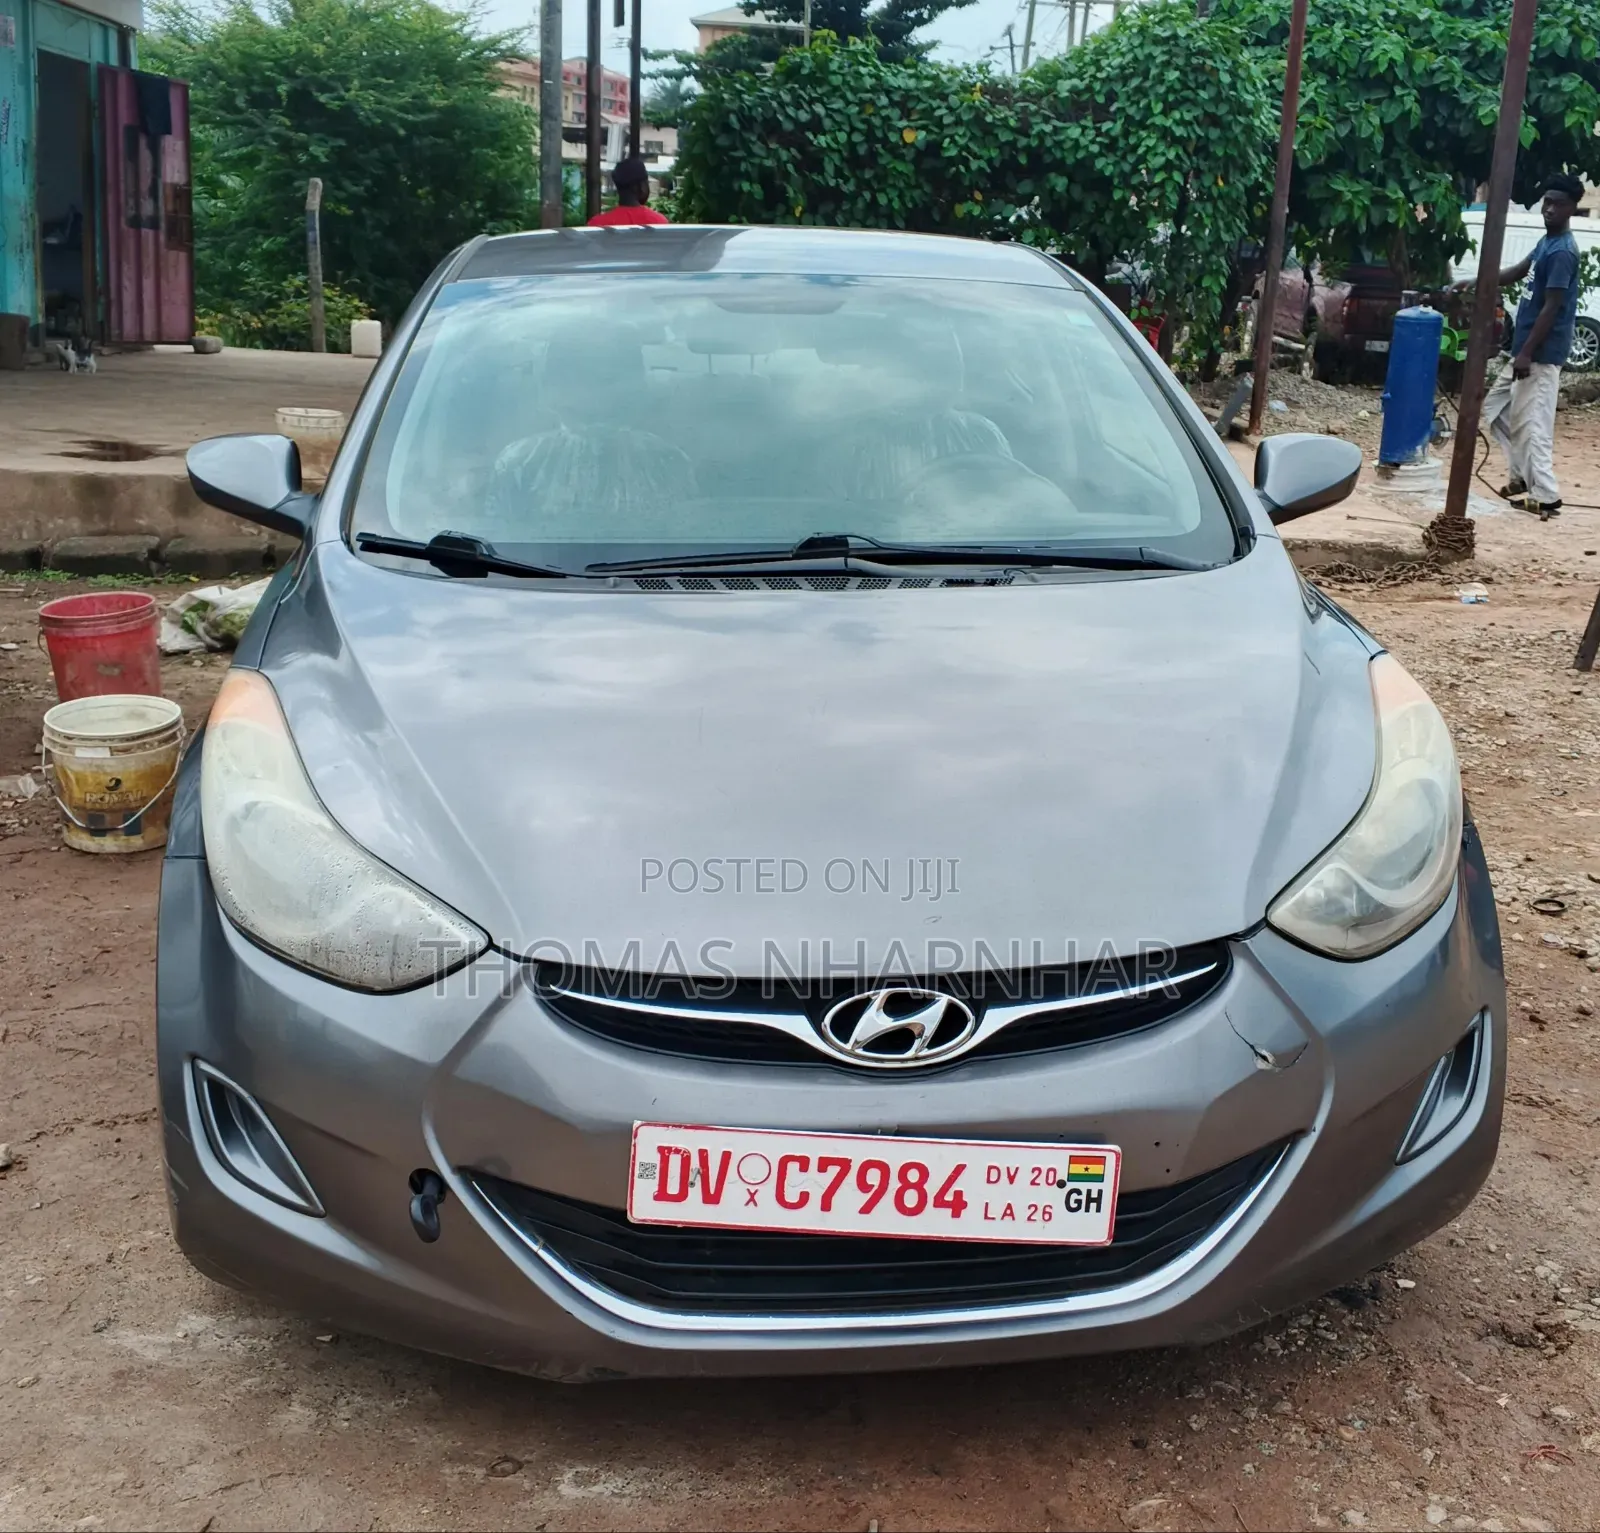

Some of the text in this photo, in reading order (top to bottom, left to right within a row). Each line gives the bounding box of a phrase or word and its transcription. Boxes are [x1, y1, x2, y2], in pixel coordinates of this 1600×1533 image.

[653, 1146, 968, 1218] DV C7984
[986, 1165, 1057, 1186] DV 20
[984, 1202, 1053, 1222] LA 26
[1064, 1188, 1103, 1213] GH
